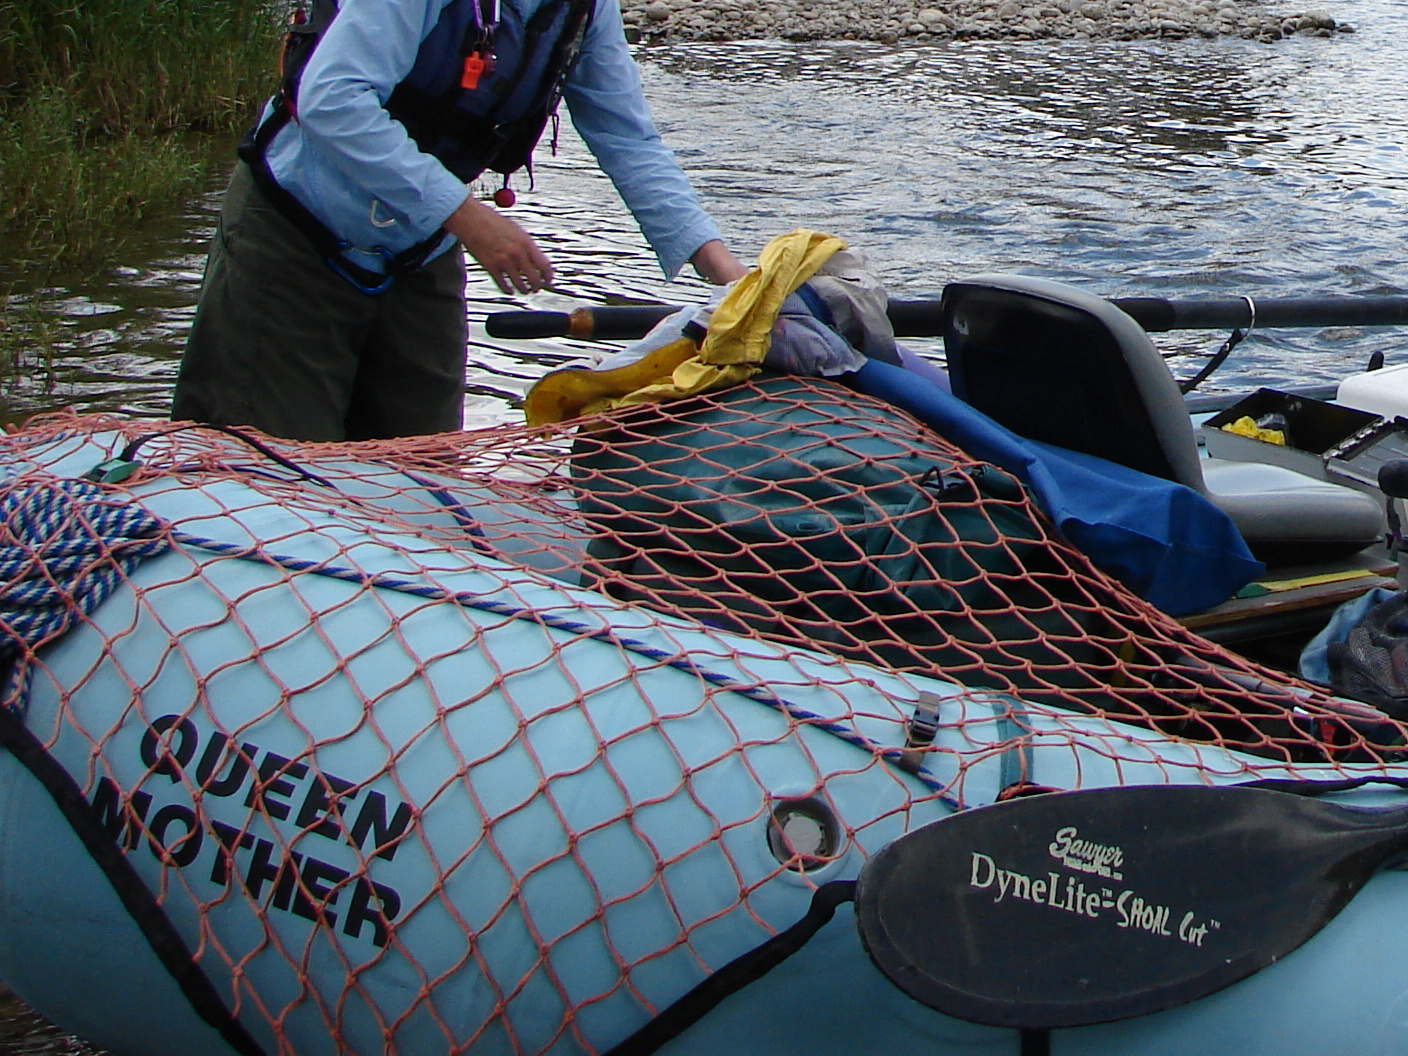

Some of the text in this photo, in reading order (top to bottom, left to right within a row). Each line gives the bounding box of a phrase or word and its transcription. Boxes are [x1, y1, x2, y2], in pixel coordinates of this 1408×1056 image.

[140, 714, 413, 861] QUEEN
[1049, 826, 1124, 870] Sawyer
[91, 776, 402, 949] MOTHER
